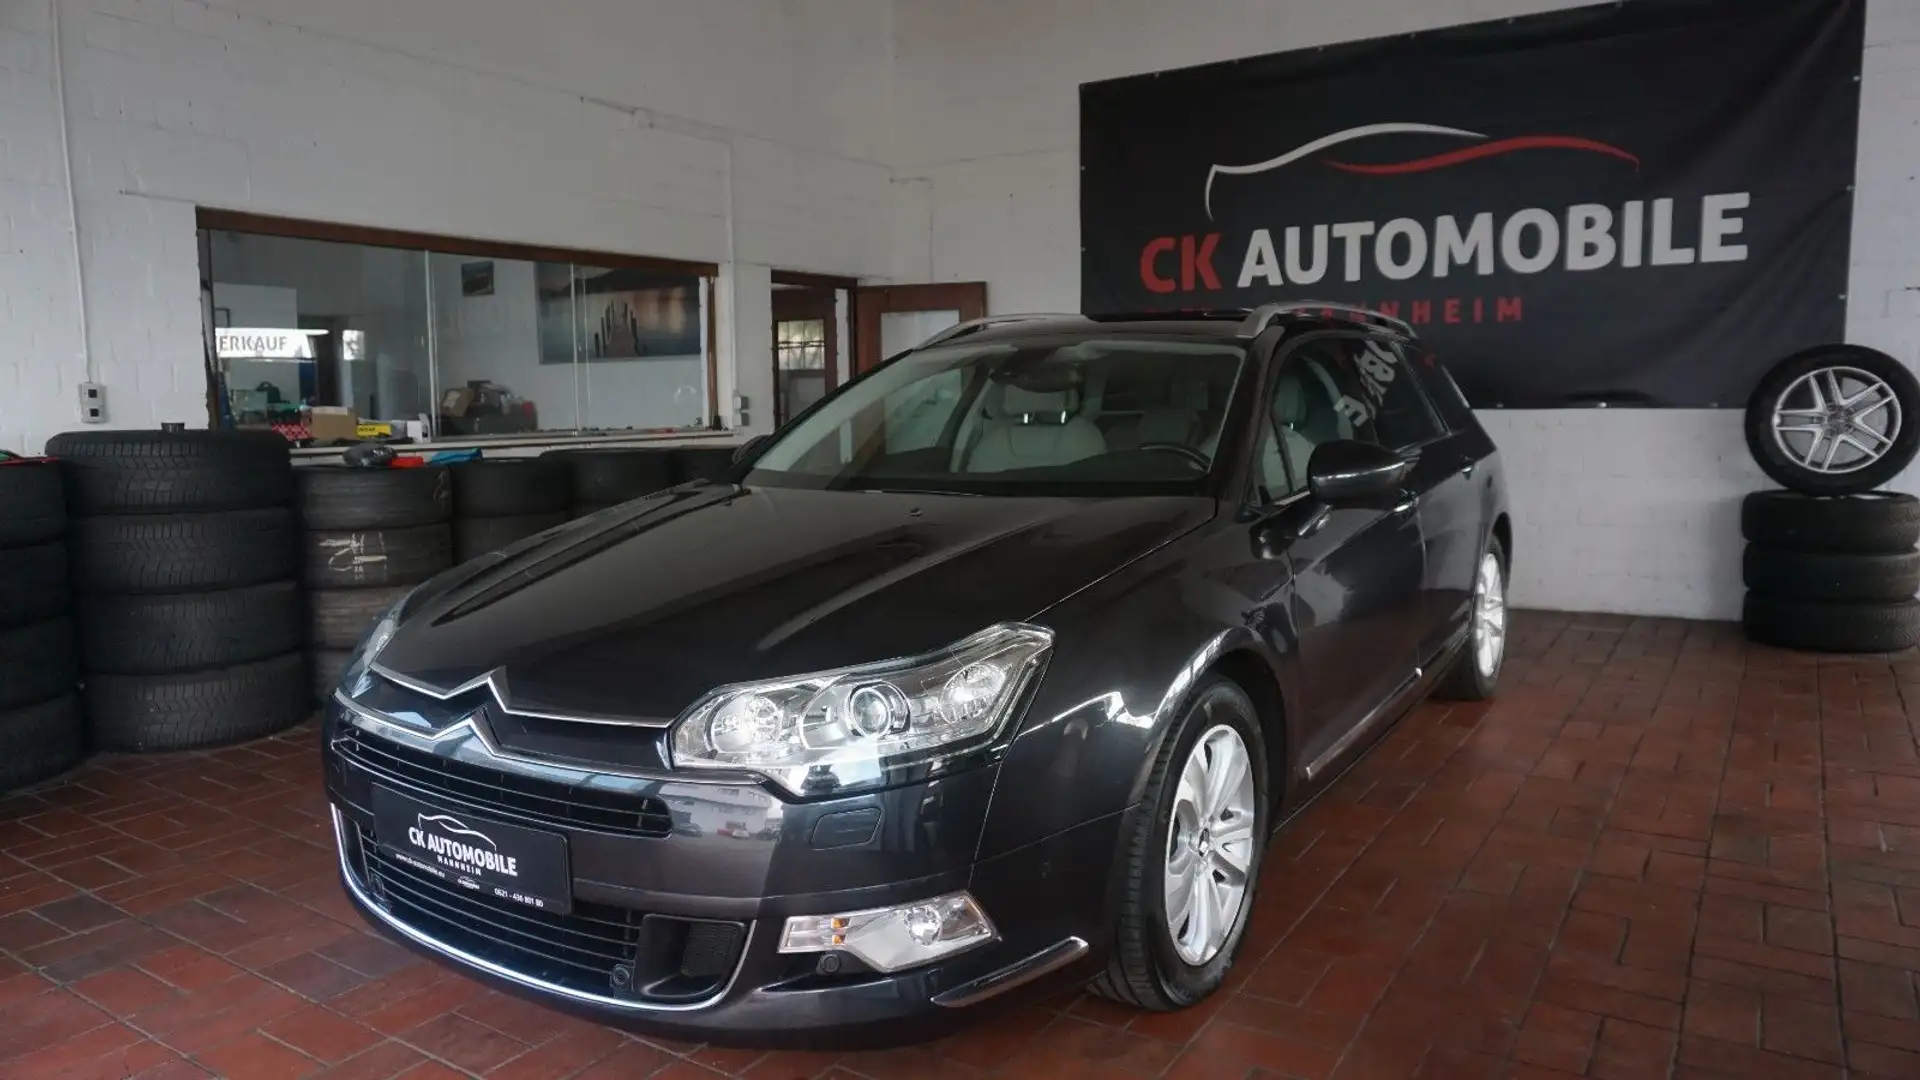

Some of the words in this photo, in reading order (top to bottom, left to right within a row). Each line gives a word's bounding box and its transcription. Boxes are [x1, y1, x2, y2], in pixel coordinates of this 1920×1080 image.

[1140, 232, 1223, 292] CK
[1237, 192, 1751, 288] AUTOMOBILE
[219, 335, 287, 351] ERKAUF
[408, 826, 426, 848] CK
[427, 833, 518, 876] AUTOMOBILE
[437, 854, 482, 876] MANNHEIM
